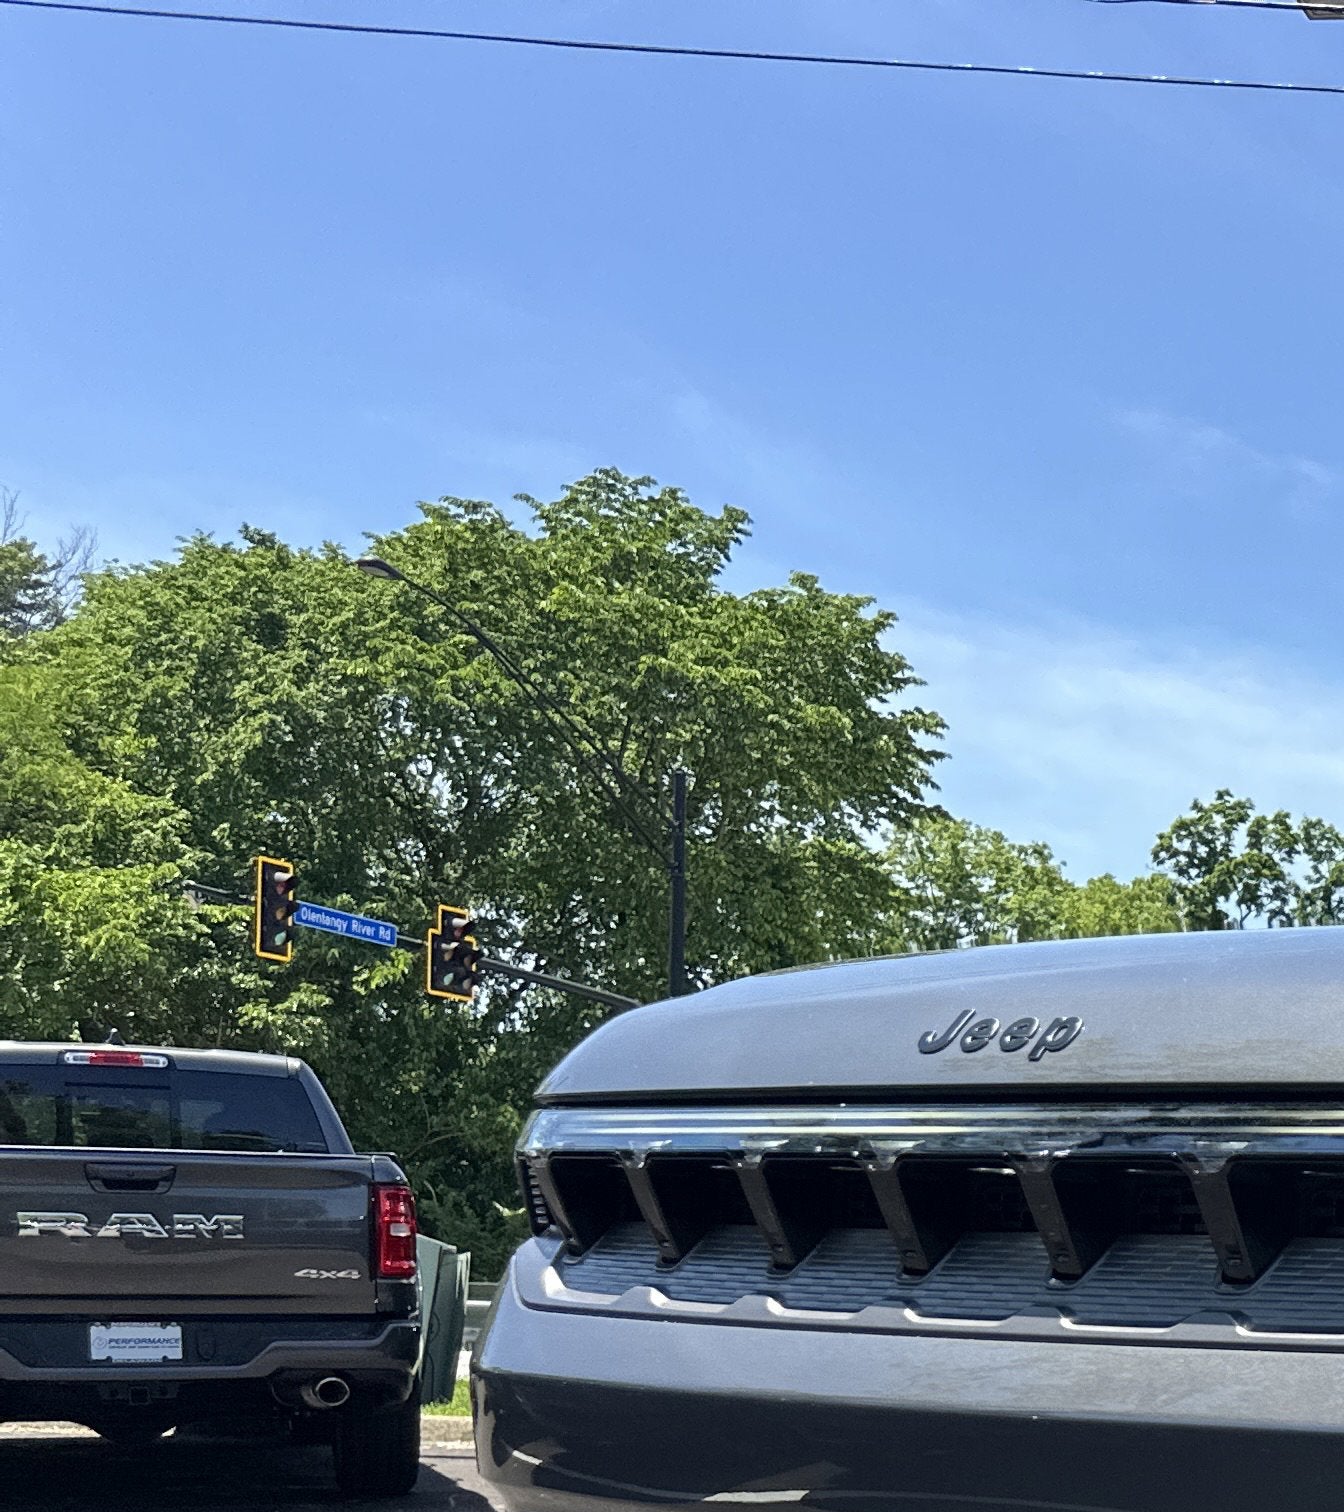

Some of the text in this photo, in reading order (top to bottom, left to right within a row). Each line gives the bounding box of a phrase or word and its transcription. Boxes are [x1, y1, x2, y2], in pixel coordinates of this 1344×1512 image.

[301, 906, 392, 942] Olentangy River Rd
[917, 1007, 1086, 1062] Jeep
[16, 1211, 246, 1239] RAM
[293, 1267, 362, 1280] 4x4
[108, 1336, 181, 1346] PERFORMANCE
